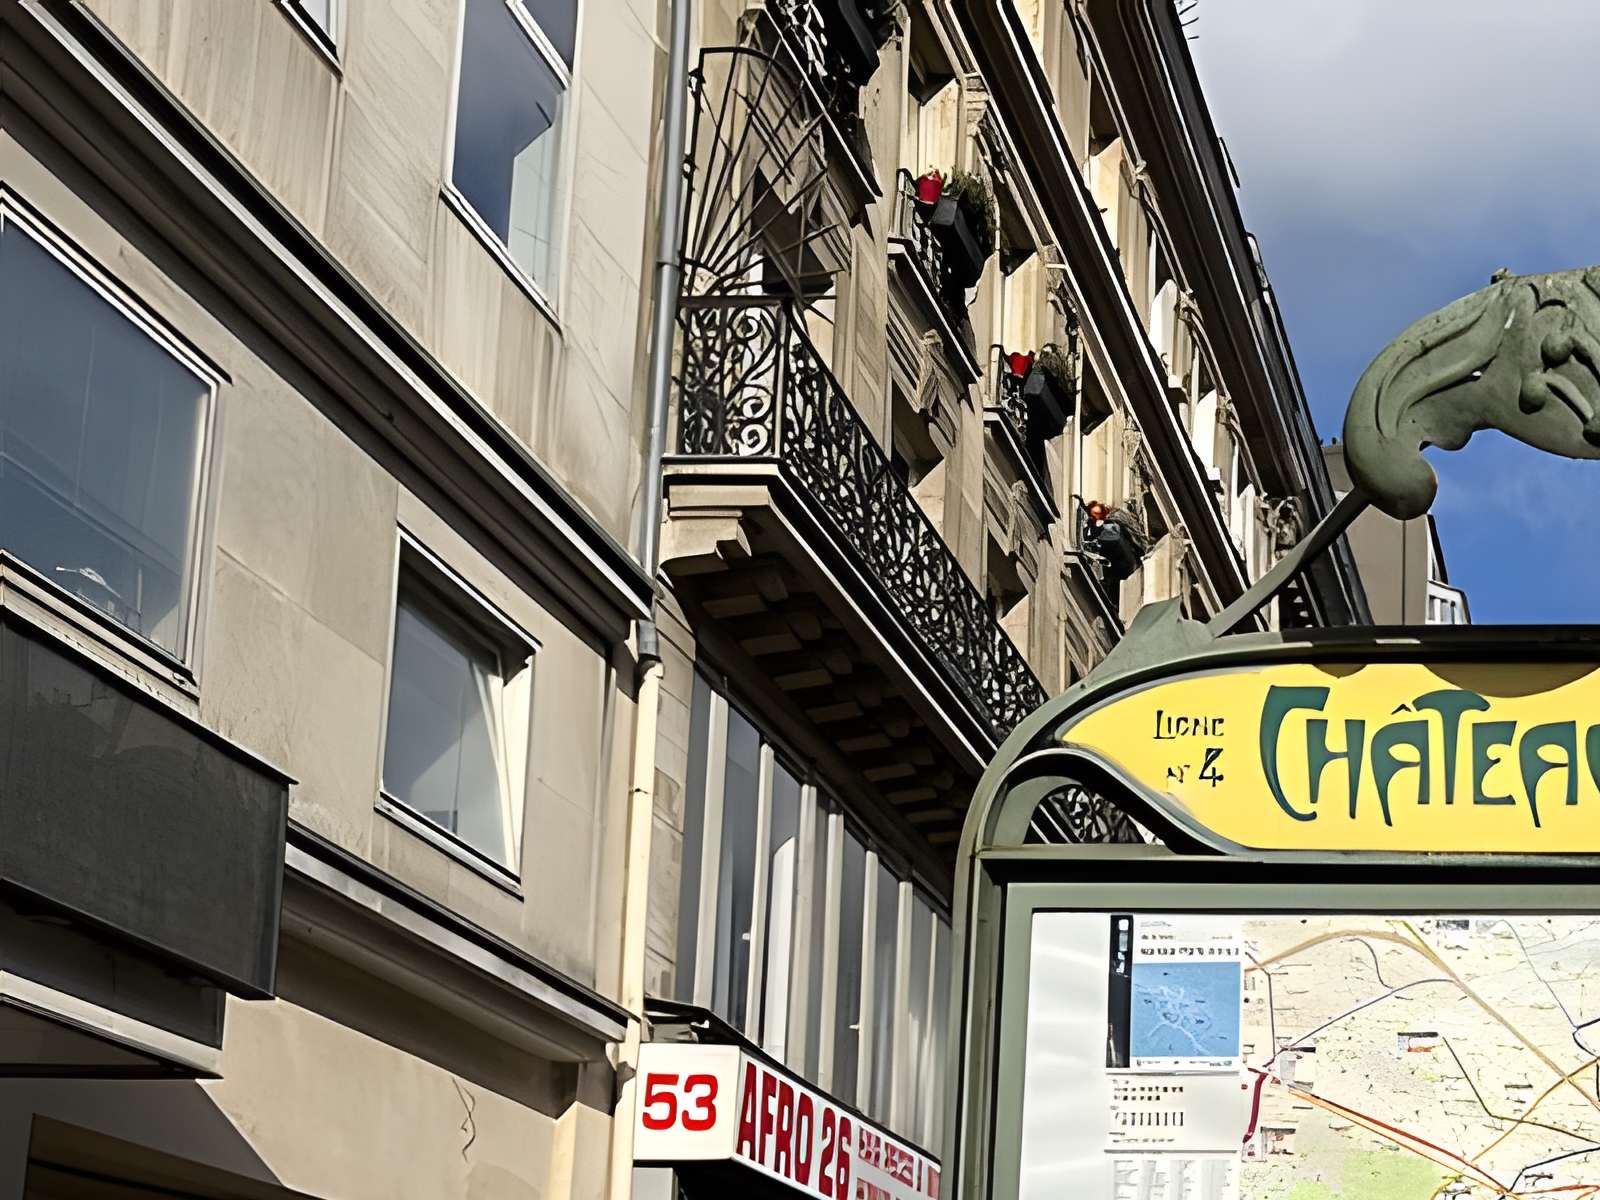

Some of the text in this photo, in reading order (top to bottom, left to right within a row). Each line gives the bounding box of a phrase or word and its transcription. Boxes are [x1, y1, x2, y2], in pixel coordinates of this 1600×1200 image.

[1198, 747, 1225, 788] 4
[642, 1072, 719, 1132] 53
[736, 1060, 815, 1187] AFRO
